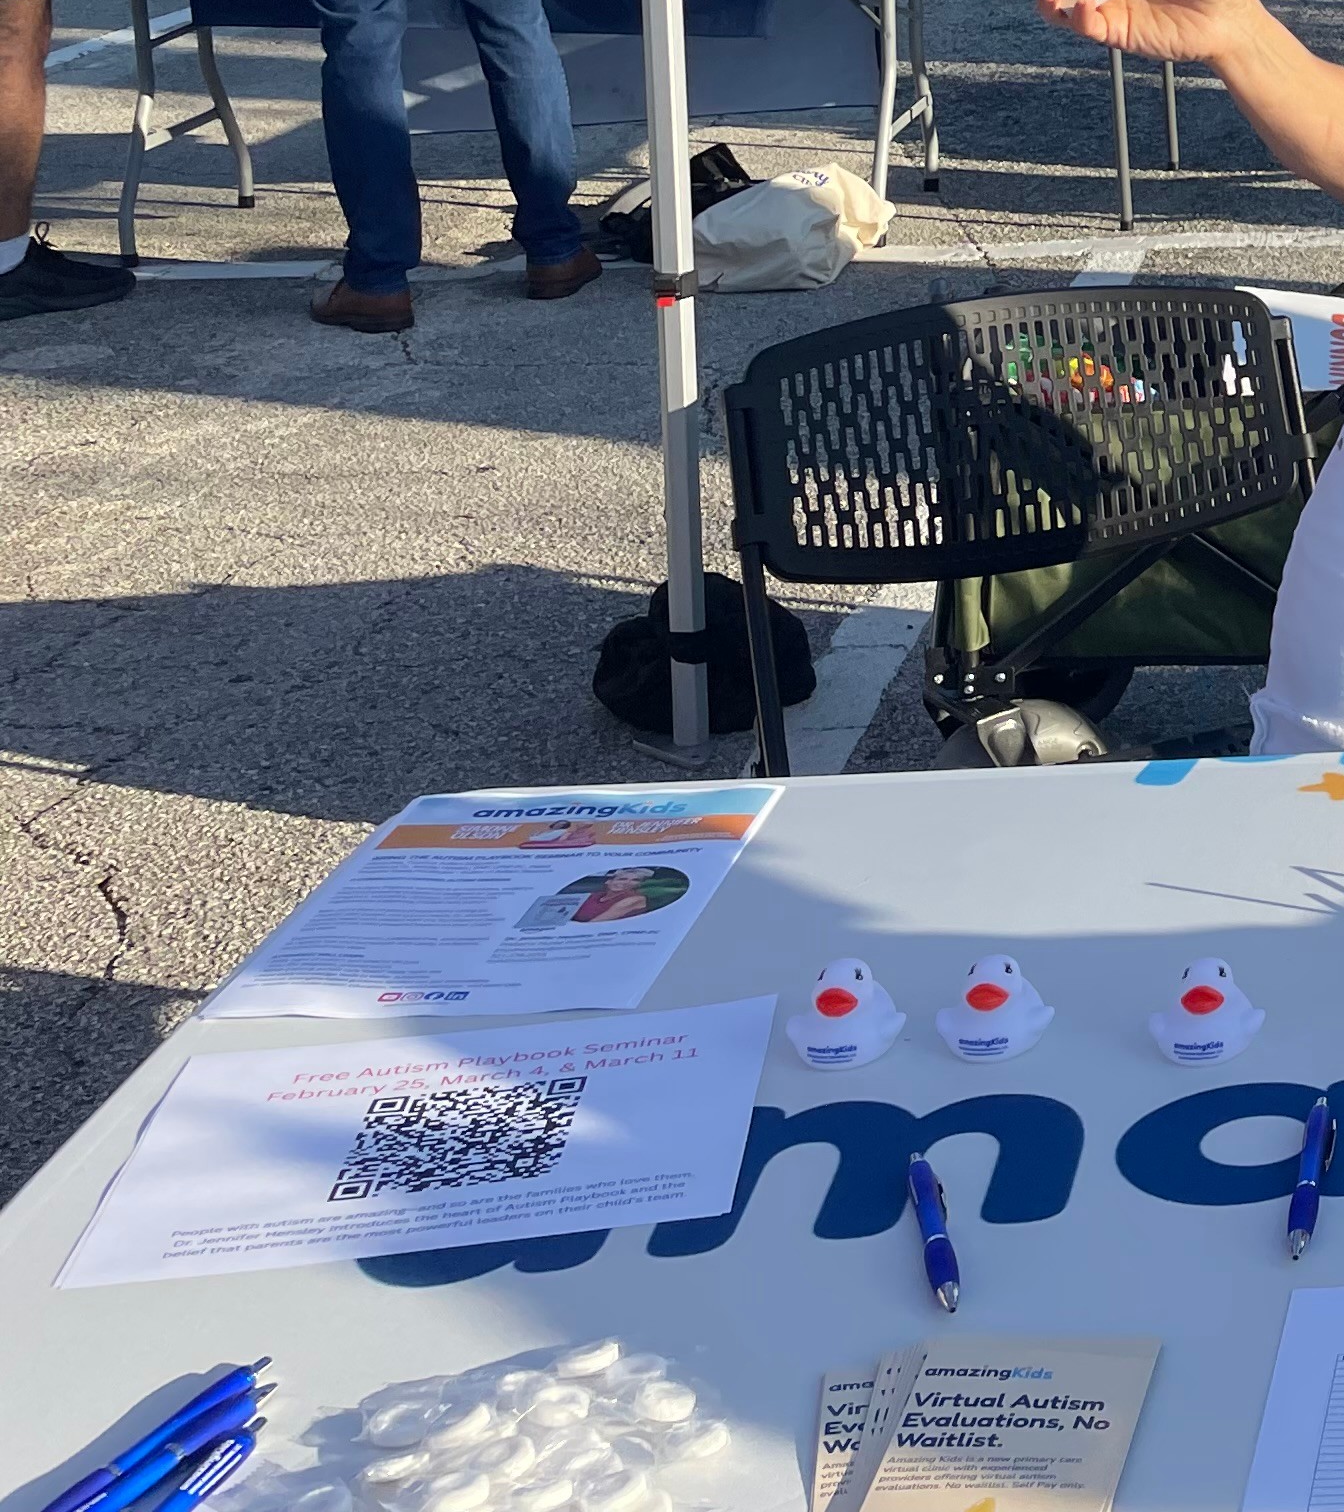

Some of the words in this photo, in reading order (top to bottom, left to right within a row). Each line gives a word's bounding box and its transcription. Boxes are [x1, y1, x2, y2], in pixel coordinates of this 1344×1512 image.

[473, 800, 687, 819] amazingKids
[293, 1070, 352, 1085] Free
[362, 1060, 449, 1079] Autism
[457, 1048, 576, 1073] Playbook
[584, 1033, 690, 1055] Seminar
[267, 1084, 387, 1104] February
[396, 1076, 430, 1092] 25,
[440, 1067, 521, 1087] March
[559, 1060, 576, 1074] &
[584, 1051, 666, 1073] March
[673, 1047, 699, 1060] 11
[925, 1365, 1053, 1381] amazingKids
[915, 1391, 1006, 1409] Virtual
[1009, 1393, 1106, 1412] Autism
[902, 1411, 1065, 1432] Evaluations,
[1072, 1415, 1111, 1432] No
[896, 1432, 1004, 1450] Waitlist.
